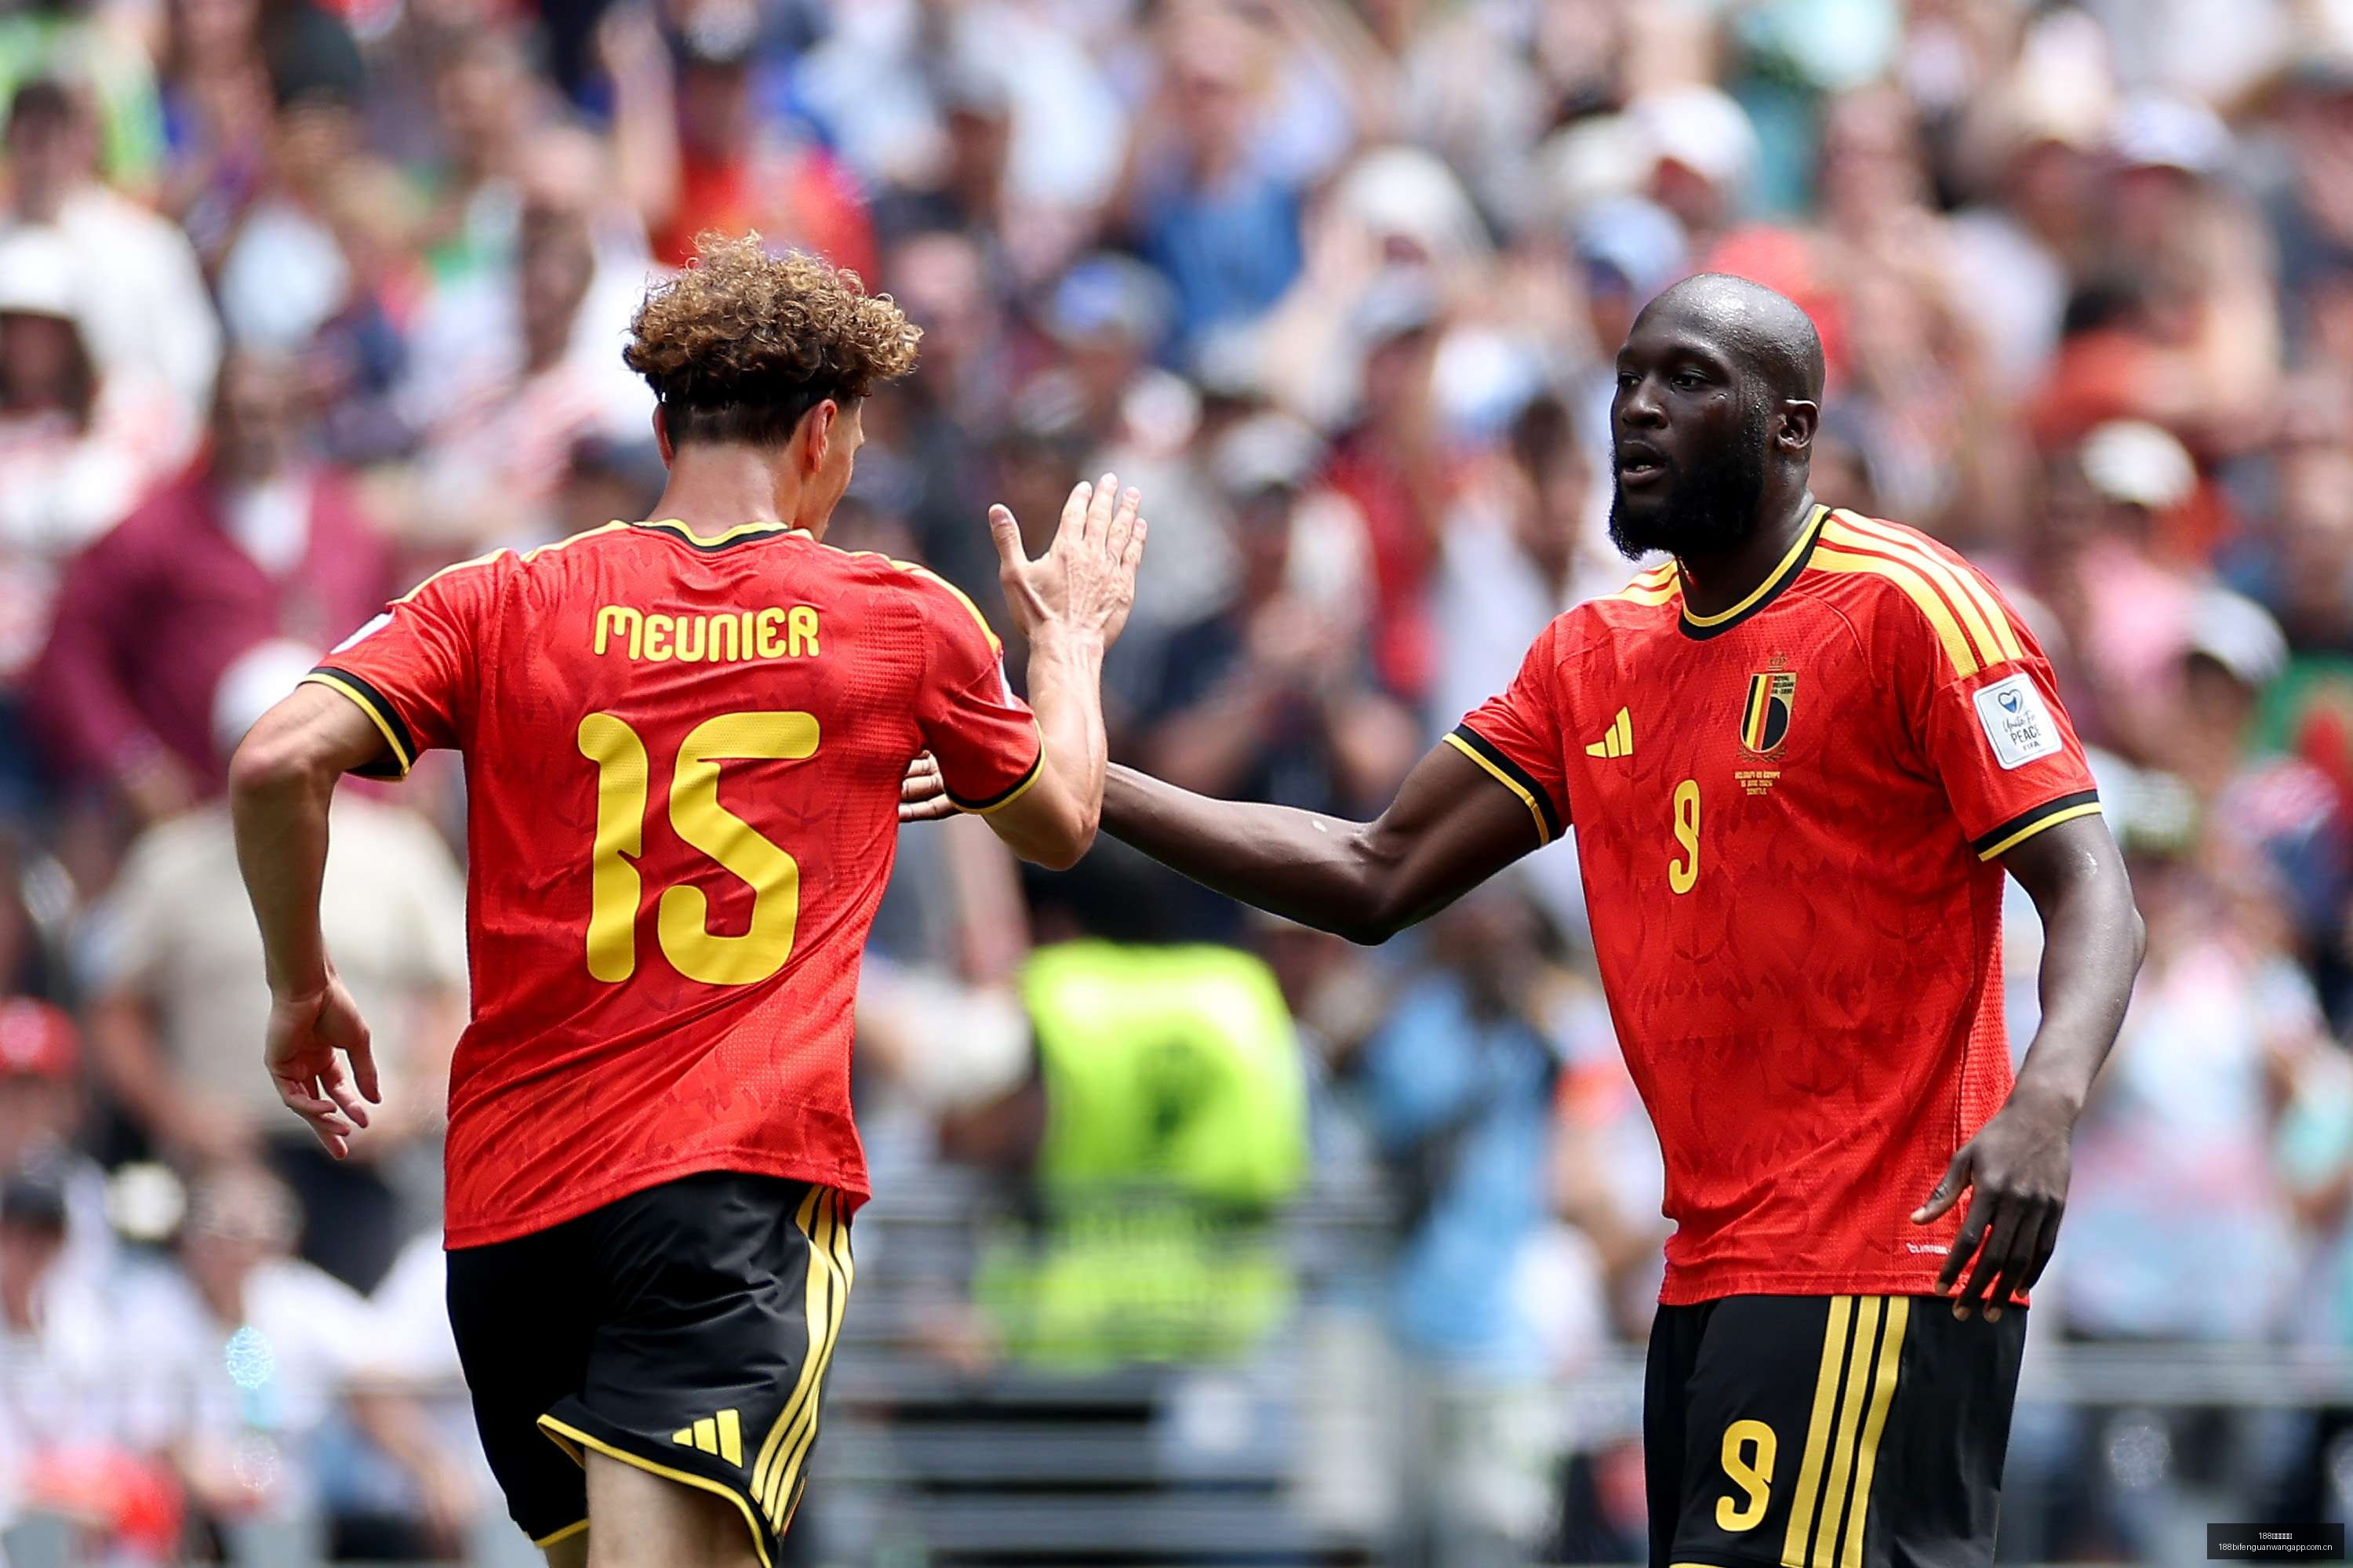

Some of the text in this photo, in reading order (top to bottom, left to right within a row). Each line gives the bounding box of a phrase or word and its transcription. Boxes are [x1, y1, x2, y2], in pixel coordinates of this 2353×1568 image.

[594, 605, 820, 662] MEUNIER
[2009, 723, 2042, 745] PEACE
[578, 711, 820, 985] 15
[1669, 779, 1700, 894] 9
[1715, 1419, 1777, 1532] 9
